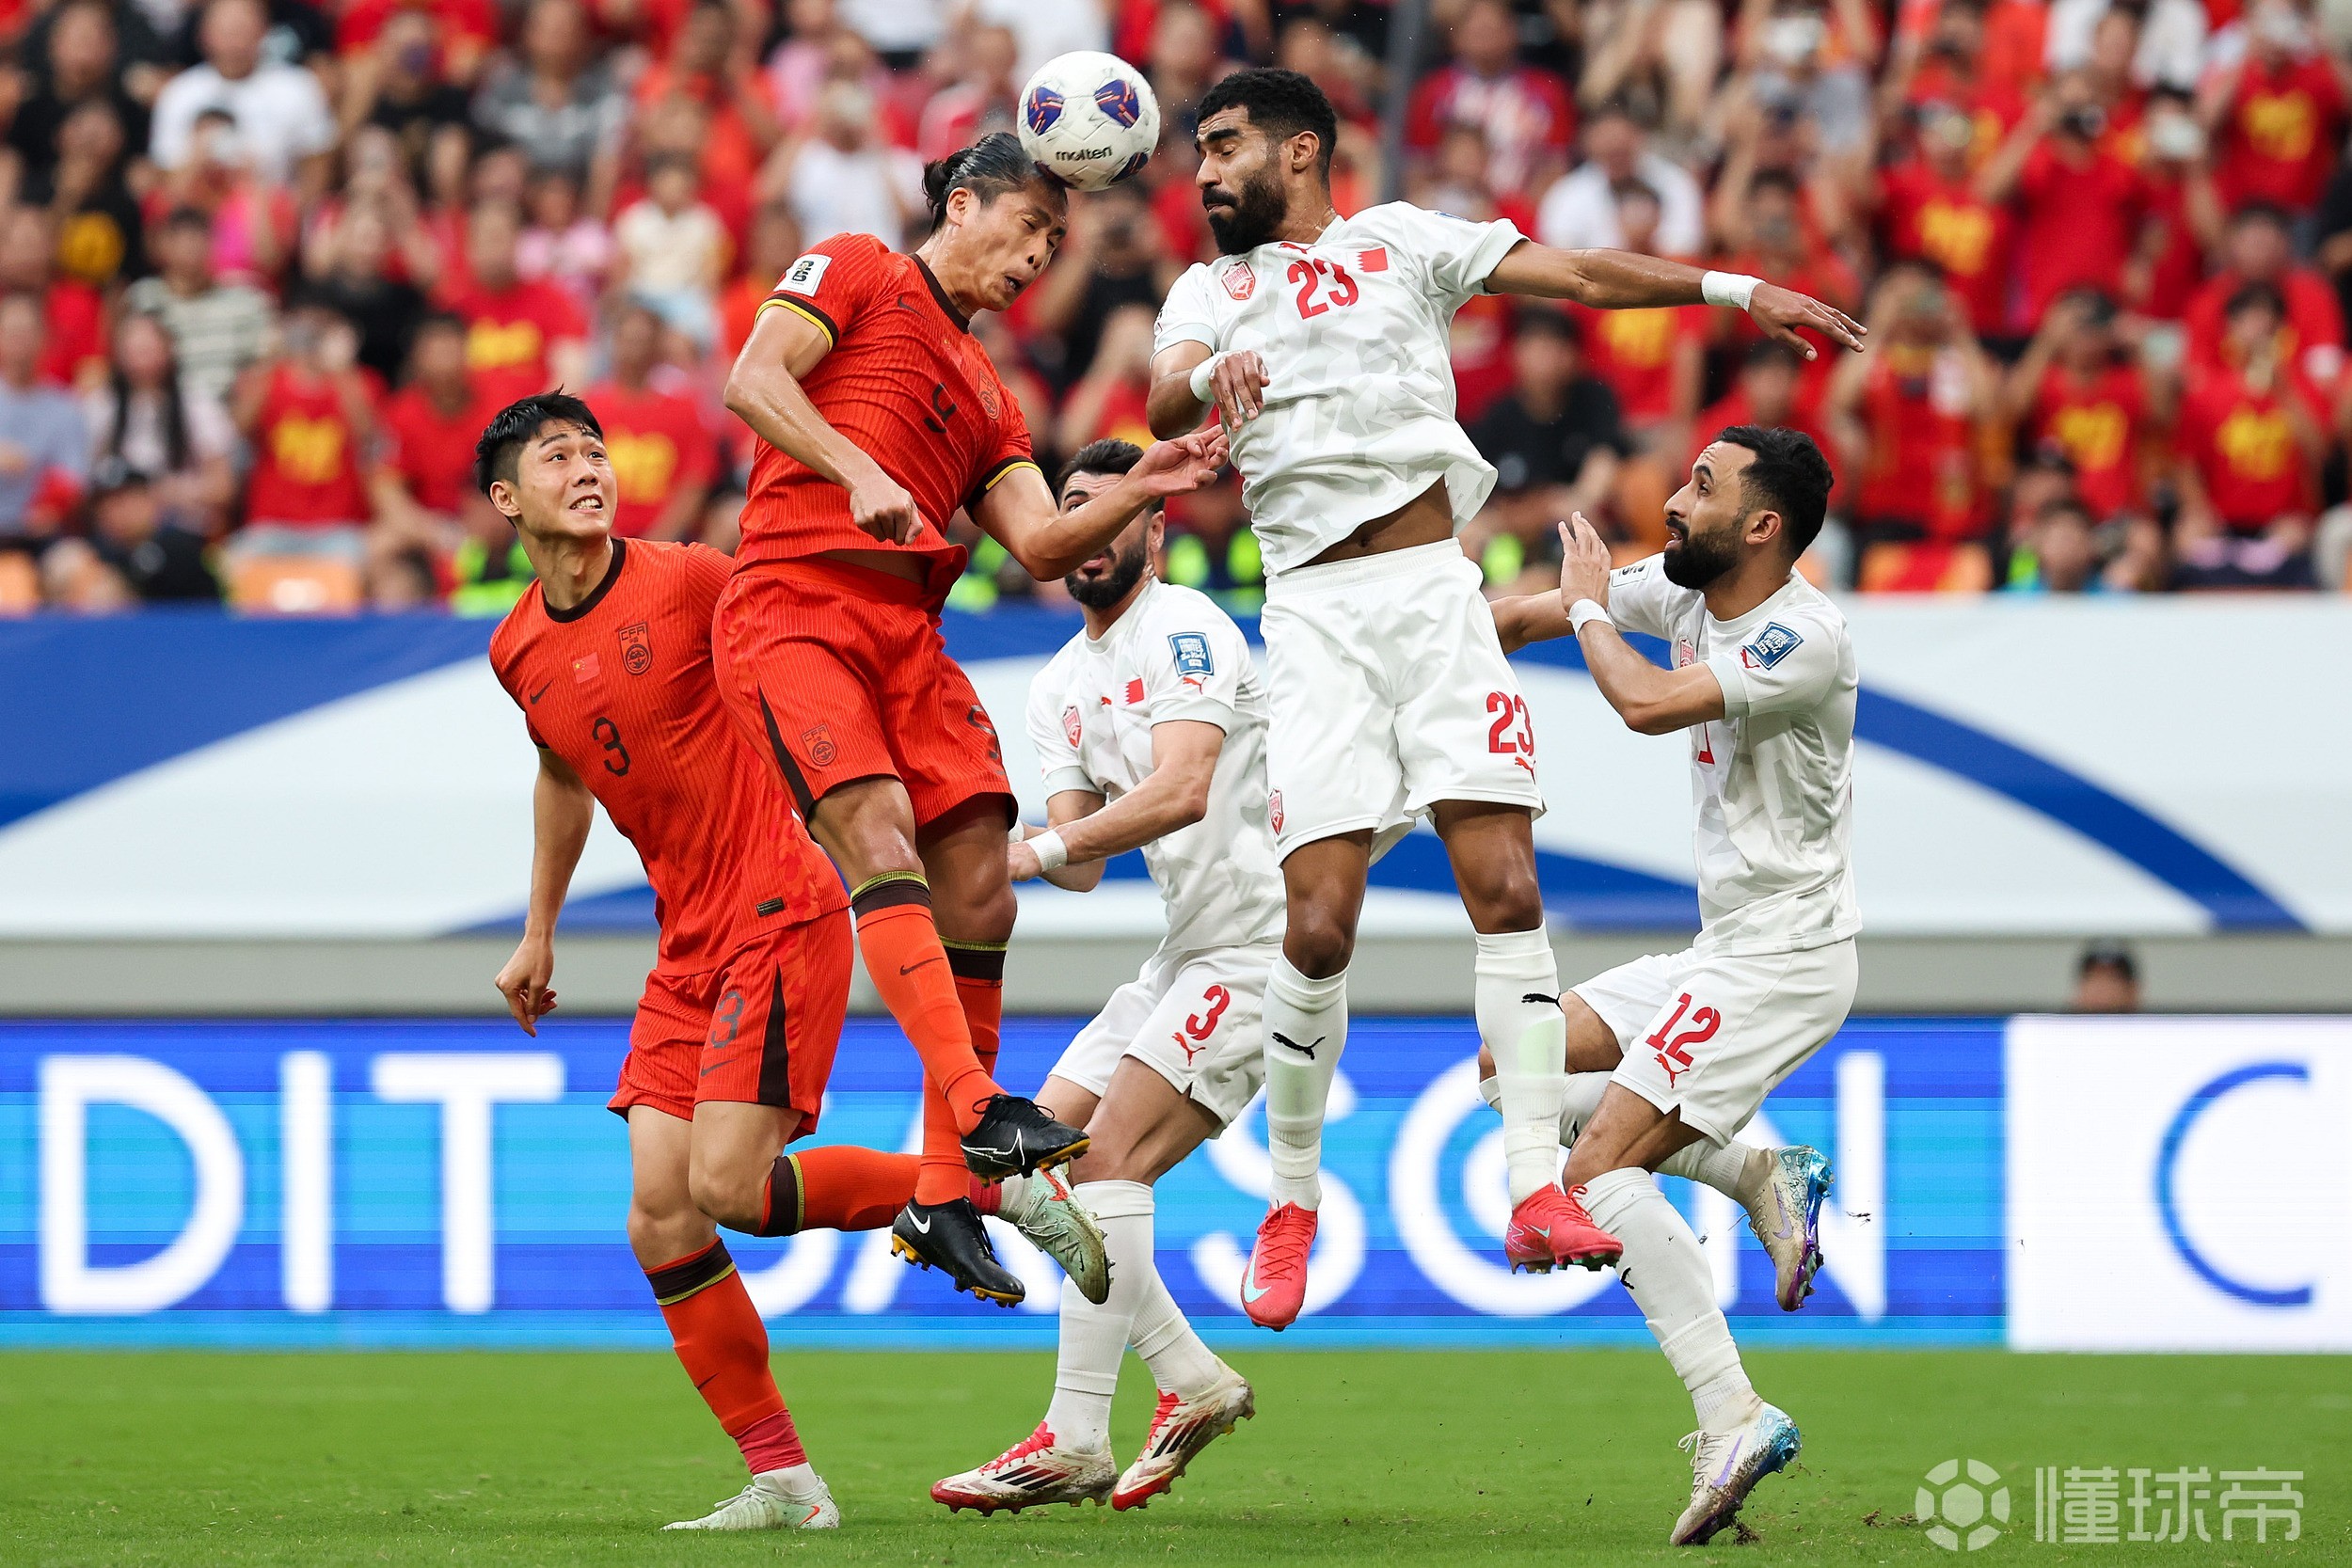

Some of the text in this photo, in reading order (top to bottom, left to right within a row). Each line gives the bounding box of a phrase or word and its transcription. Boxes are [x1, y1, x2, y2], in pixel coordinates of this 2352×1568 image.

[1056, 145, 1113, 161] molten
[1286, 258, 1359, 320] 23
[621, 626, 645, 641] CFA
[592, 716, 631, 777] 3
[1486, 690, 1534, 756] 23
[711, 990, 745, 1049] 3
[1185, 985, 1231, 1041] 3
[1645, 992, 1721, 1068] 12
[38, 1049, 565, 1315] DIT
[2153, 1057, 2316, 1308] C
